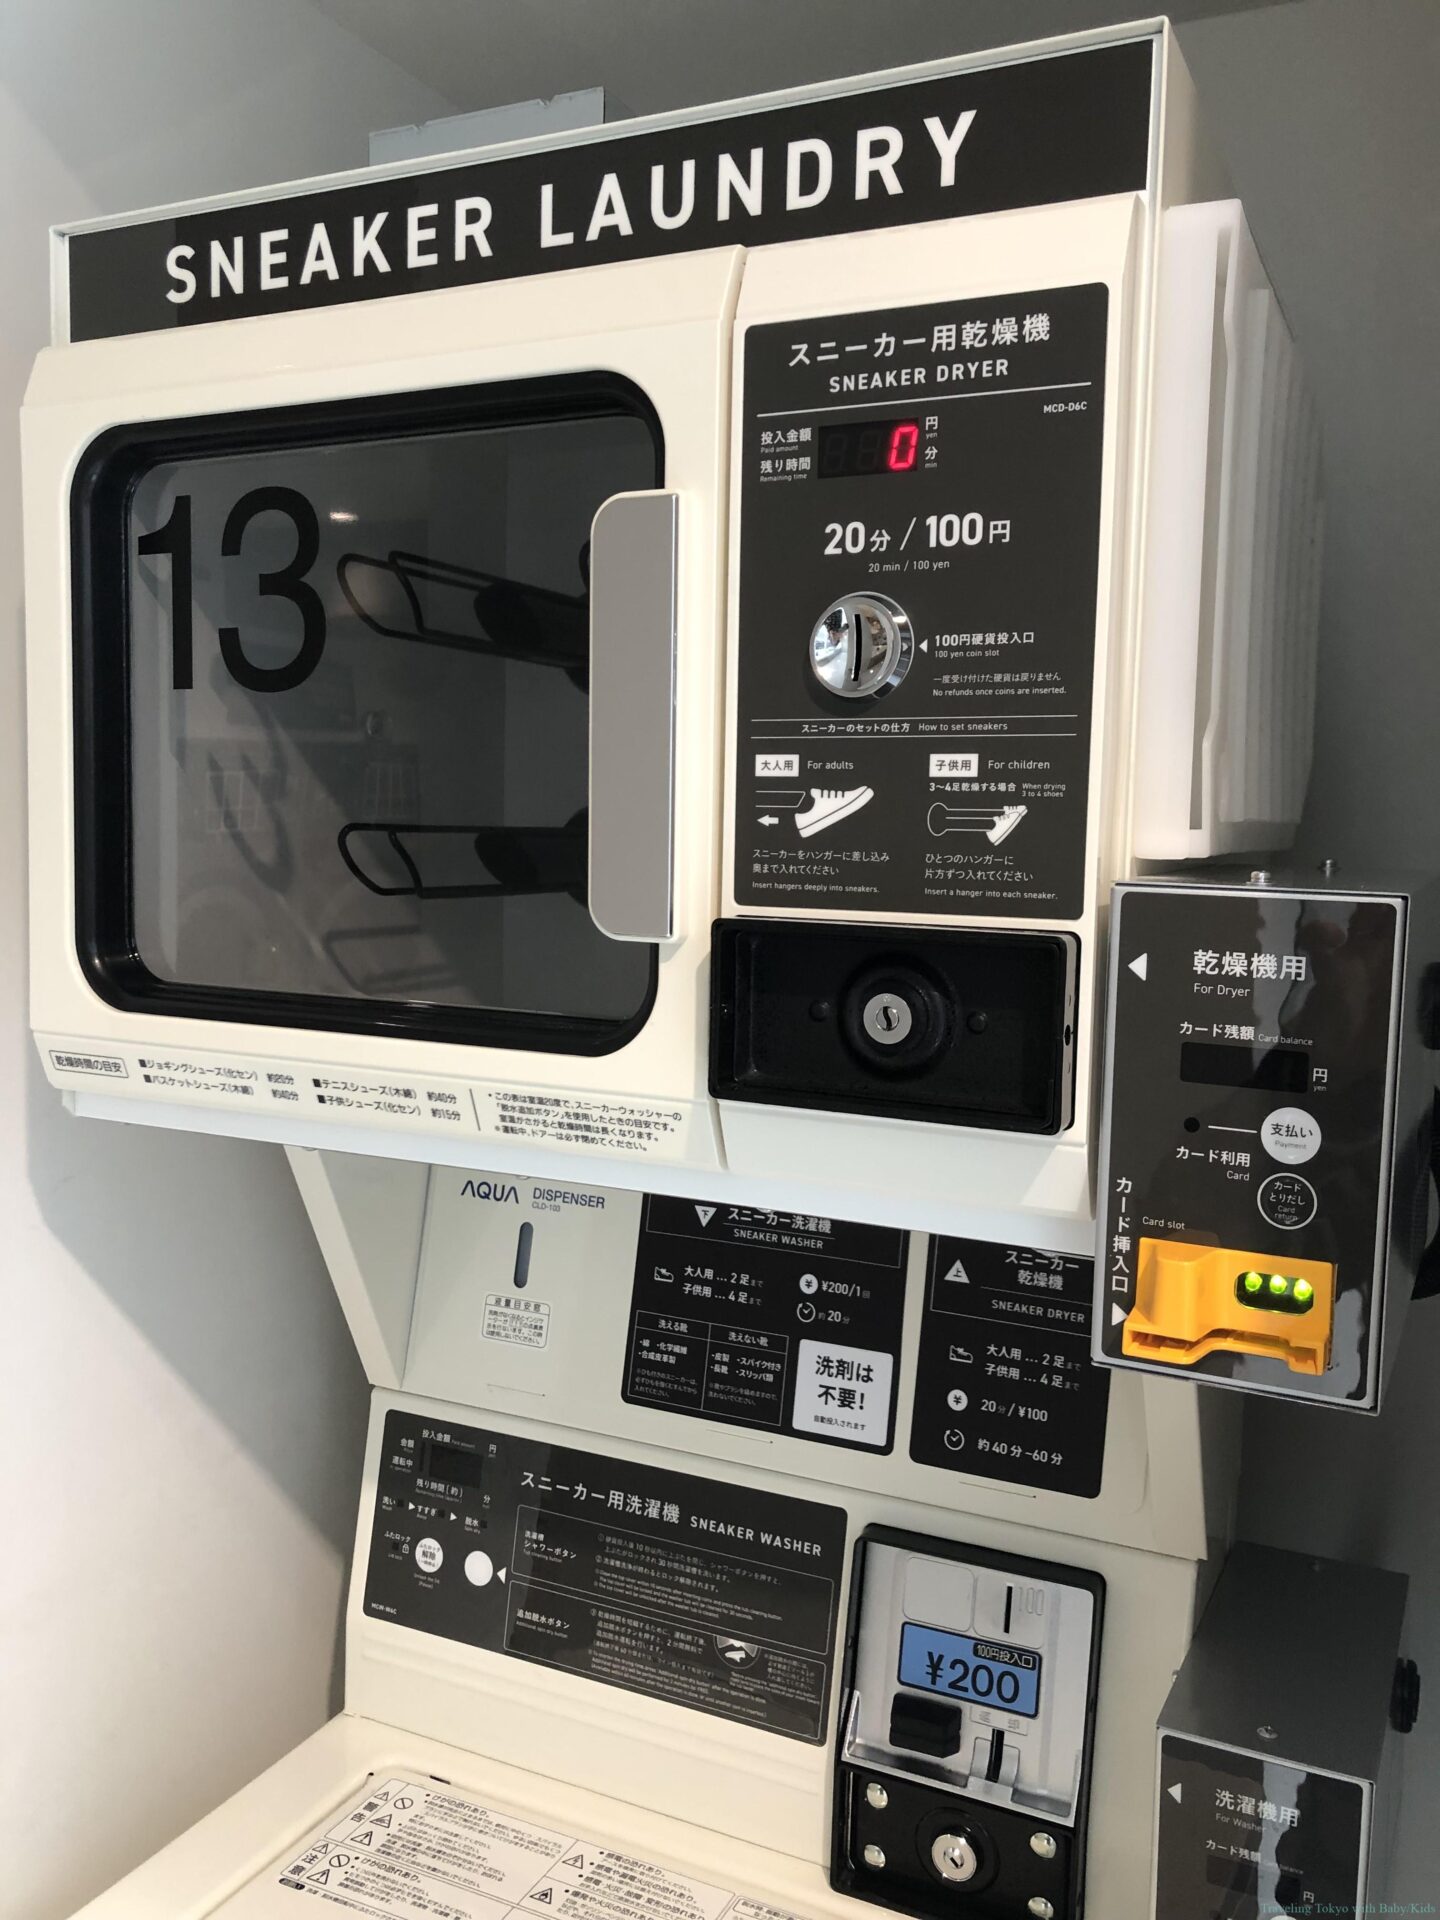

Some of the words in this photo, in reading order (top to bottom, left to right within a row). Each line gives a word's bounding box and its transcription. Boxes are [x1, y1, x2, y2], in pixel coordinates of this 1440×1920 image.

[164, 195, 494, 306] SNEAKER
[538, 109, 979, 248] LAUNDRY
[789, 313, 1051, 367] スニーカー用乾燥機
[829, 367, 927, 393] SNEAKER
[936, 358, 1010, 382] DRYER
[1043, 401, 1088, 414] MCD-D6C
[925, 416, 939, 431] 円
[760, 427, 812, 445] 投入金額
[926, 432, 938, 440] yen
[888, 425, 919, 471] 0
[925, 447, 938, 460] 分
[760, 457, 811, 474] 残り時間
[760, 475, 791, 483] Remaining
[793, 472, 808, 480] time
[868, 562, 880, 572] 20
[883, 561, 900, 571] min
[913, 559, 929, 570] 100
[933, 560, 950, 571] yen
[137, 486, 327, 693] 13
[935, 631, 1035, 647] 100円硬貨投入口
[935, 650, 948, 659] 100
[950, 651, 963, 660] yen
[965, 650, 982, 658] coin
[984, 648, 999, 657] slot
[933, 672, 1062, 684] 一度受け付けた硬貨は戻りません
[933, 688, 942, 696] No
[945, 688, 973, 696] refunds
[975, 688, 993, 696] once
[995, 687, 1014, 695] coins
[1032, 686, 1067, 694] inserted.
[801, 721, 910, 733] スニーカーのセットの仕方
[919, 722, 937, 731] How
[939, 722, 948, 731] to
[951, 722, 965, 731] set
[967, 721, 1008, 731] sneakers
[761, 759, 794, 771] 大人用
[807, 760, 822, 769] For
[825, 759, 854, 769] adults
[935, 759, 972, 771] 子供用
[988, 760, 1004, 769] For
[1008, 759, 1050, 769] children
[1043, 782, 1066, 791] drying
[753, 849, 890, 862] スニーカーをハンガーに差し込み
[925, 854, 1014, 865] ひとつのハンガーに
[753, 864, 839, 875] 奥まで入れてください
[925, 869, 1033, 881] 片方ずつ入れてください
[774, 883, 802, 892] hangers
[804, 884, 827, 893] deeply
[845, 885, 880, 893] sneakers.
[925, 888, 947, 896] Insert
[956, 889, 984, 898] hanger
[1193, 949, 1307, 981] 乾燥機用
[1193, 983, 1214, 995] For
[1217, 984, 1251, 998] Dryer
[1179, 1021, 1255, 1041] カード残額
[1258, 1033, 1278, 1043] Card
[1280, 1034, 1313, 1046] balance
[55, 1055, 122, 1073] 乾燥時間の目安
[1312, 1068, 1328, 1083] 円
[1270, 1123, 1313, 1138] 支払い
[1275, 1139, 1307, 1150] Payment
[1176, 1146, 1250, 1167] カード利用
[1226, 1170, 1250, 1181] Card
[461, 1180, 519, 1204] AQUA
[533, 1188, 605, 1208] DISPENSER
[1274, 1181, 1301, 1192] カード
[1270, 1192, 1307, 1206] とりだし
[1278, 1205, 1295, 1213] Card
[728, 1207, 832, 1234] スニーカー洗濯機
[1142, 1216, 1164, 1227] Card
[1167, 1219, 1185, 1230] slot
[733, 1228, 778, 1243] SNEAKER
[781, 1235, 824, 1249] WASHER
[1112, 1176, 1133, 1293] カード挿入口
[1005, 1250, 1079, 1271] スニーカー
[684, 1265, 714, 1280] 大人用
[1017, 1270, 1064, 1291] 乾燥機
[683, 1283, 712, 1298] 子供用
[992, 1300, 1043, 1316] SNEAKER
[1047, 1308, 1085, 1324] DRYER
[658, 1319, 688, 1332] 洗える靴
[728, 1331, 768, 1346] 洗えない靴
[986, 1344, 1022, 1361] 大人用
[815, 1355, 874, 1384] 洗剤は
[984, 1364, 1020, 1380] 子供用
[818, 1385, 865, 1411] 不要!
[1018, 1407, 1048, 1422] ¥100
[814, 1415, 866, 1431] 自動投入されます
[400, 1438, 415, 1448] 金額
[422, 1429, 451, 1443] 投入金額
[488, 1443, 497, 1454] 円
[392, 1455, 413, 1468] 運転中
[483, 1494, 491, 1504] 分
[521, 1471, 680, 1525] スニーカー用洗濯機
[690, 1516, 754, 1541] SNEAKER
[760, 1532, 822, 1557] WASHER
[524, 1540, 577, 1559] シャワーボタン
[517, 1608, 570, 1629] 追加脱水ボタン
[977, 1644, 1033, 1668] 100円投入口
[926, 1651, 1020, 1704] ¥200
[1215, 1788, 1300, 1828] 洗濯機用
[1216, 1813, 1230, 1824] For
[1233, 1817, 1267, 1832] Washer
[1303, 1891, 1315, 1904] 円
